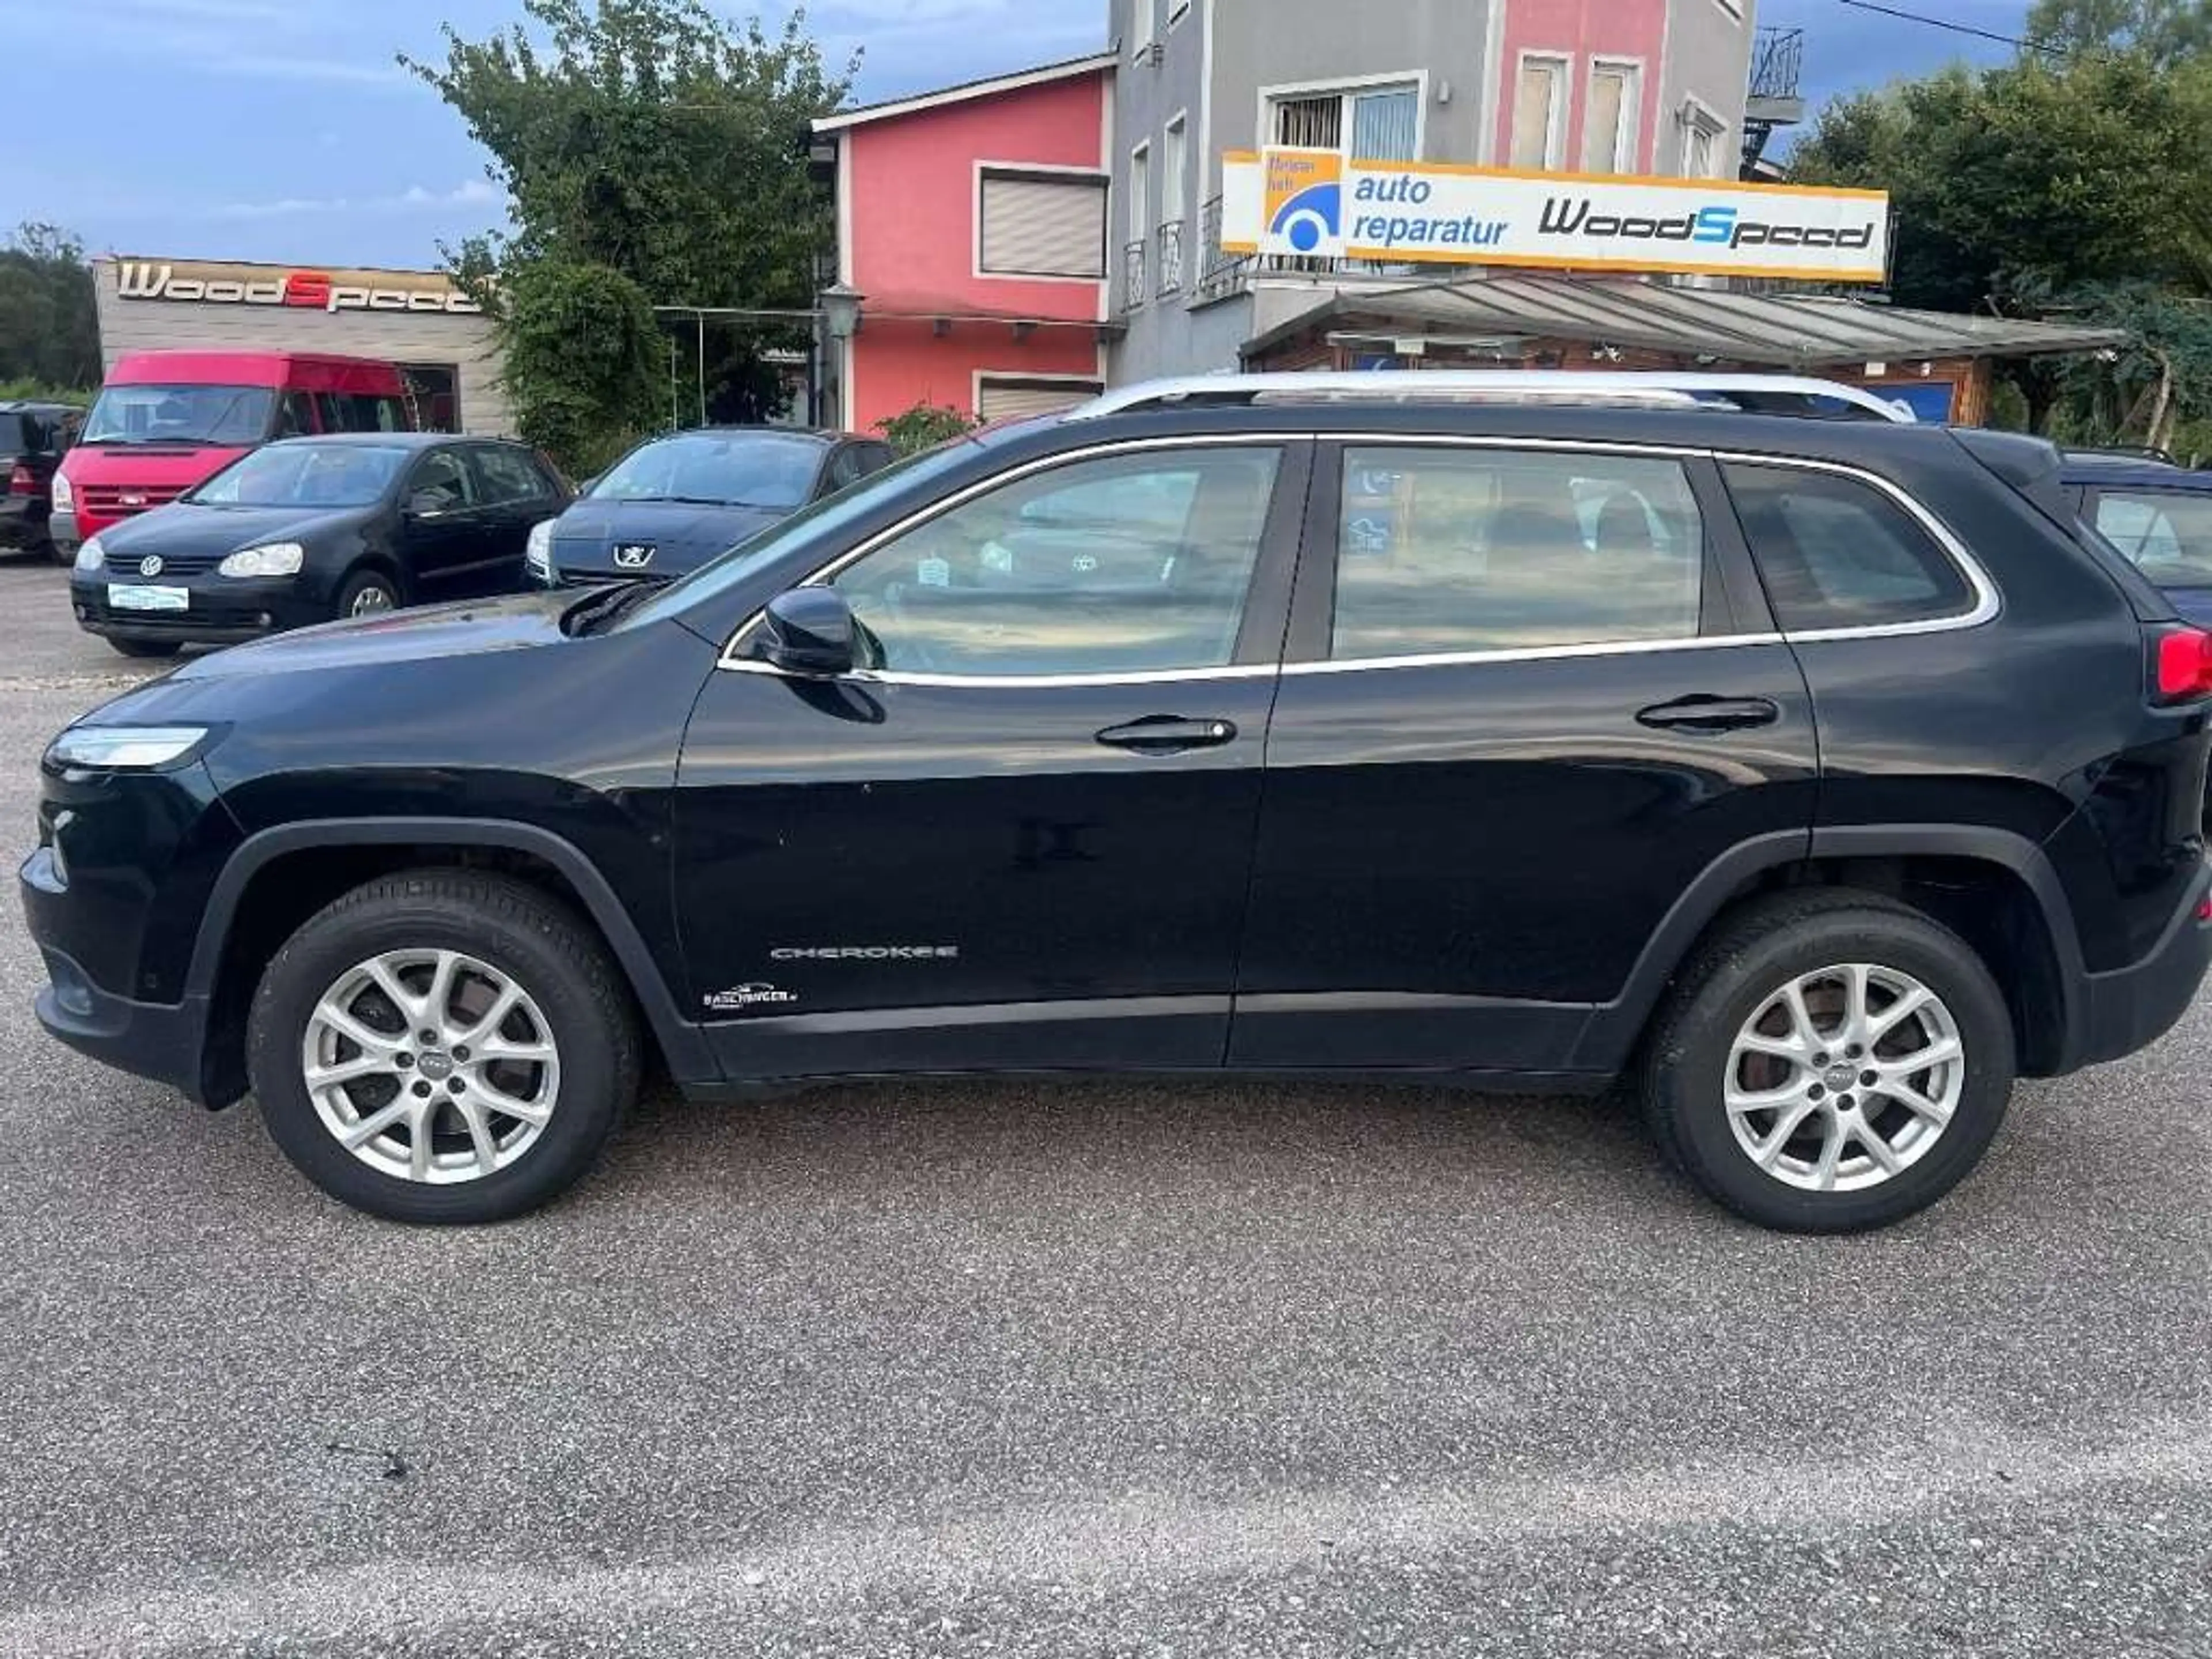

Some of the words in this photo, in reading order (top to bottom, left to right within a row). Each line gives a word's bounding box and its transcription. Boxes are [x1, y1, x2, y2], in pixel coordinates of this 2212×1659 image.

[1355, 174, 1431, 203] auto
[1353, 214, 1508, 246] reparatur
[771, 946, 958, 958] CHEROKEE
